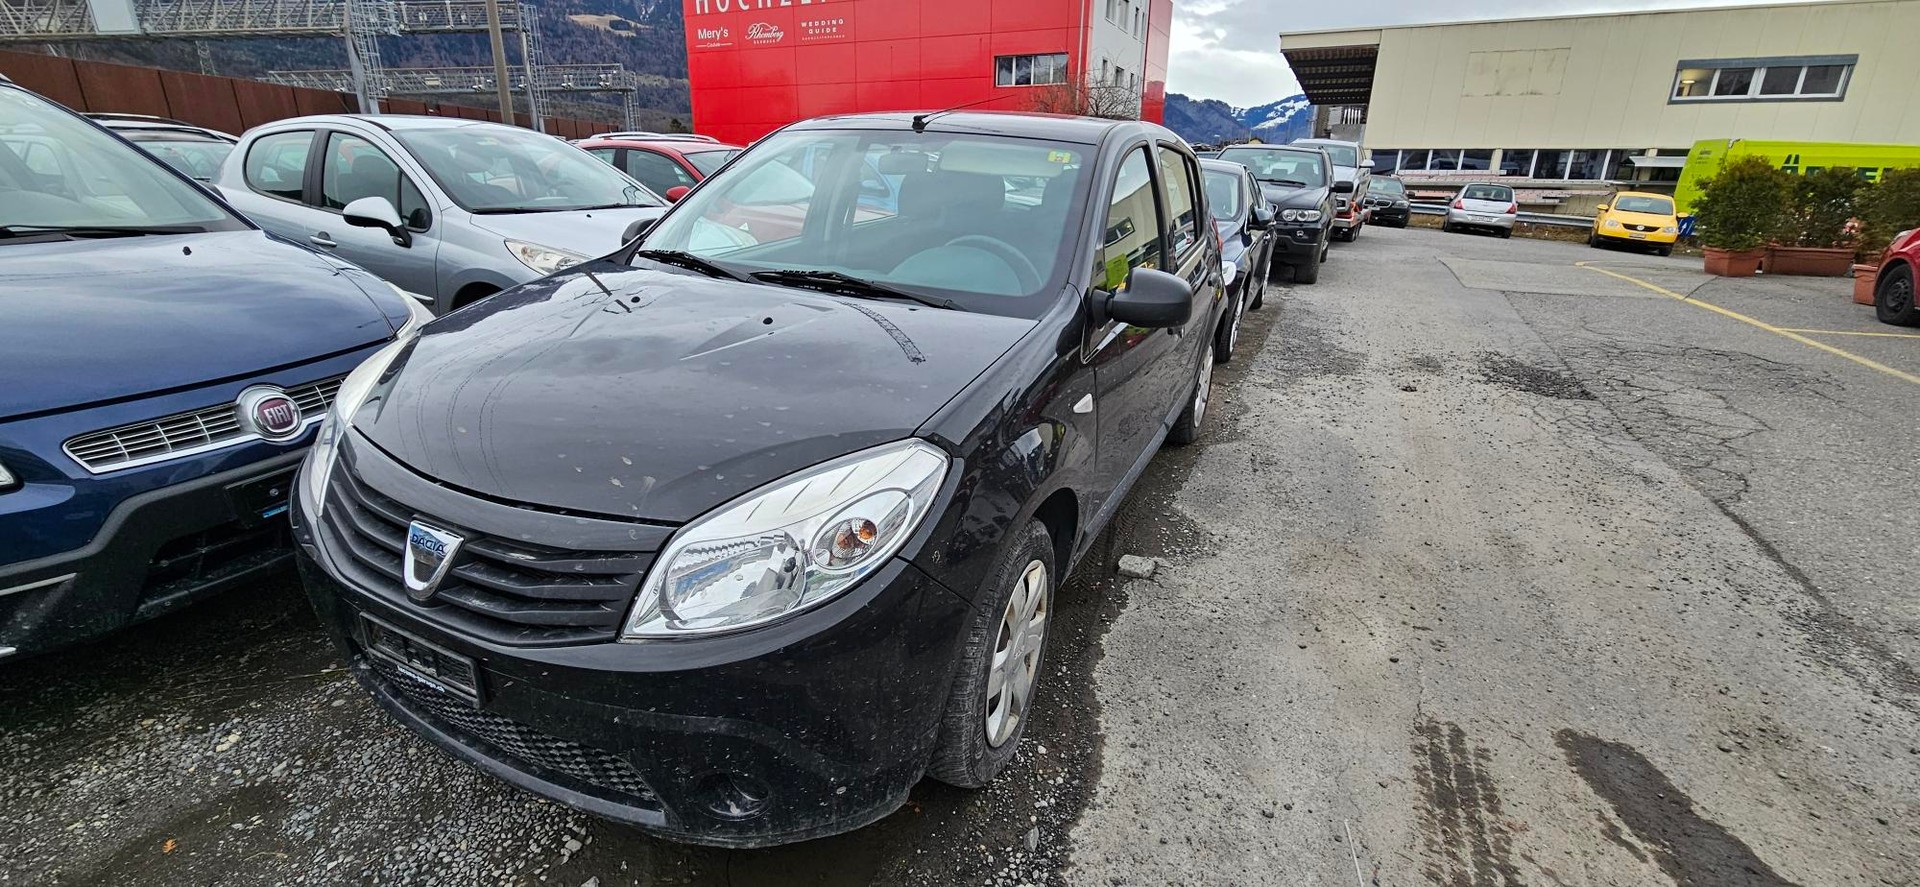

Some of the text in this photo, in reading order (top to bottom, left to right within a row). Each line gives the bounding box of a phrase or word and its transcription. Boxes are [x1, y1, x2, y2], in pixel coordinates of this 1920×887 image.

[800, 18, 844, 28] WEDDING
[697, 27, 729, 42] Mery's
[263, 404, 292, 425] FIAT
[411, 534, 446, 553] DACIA
